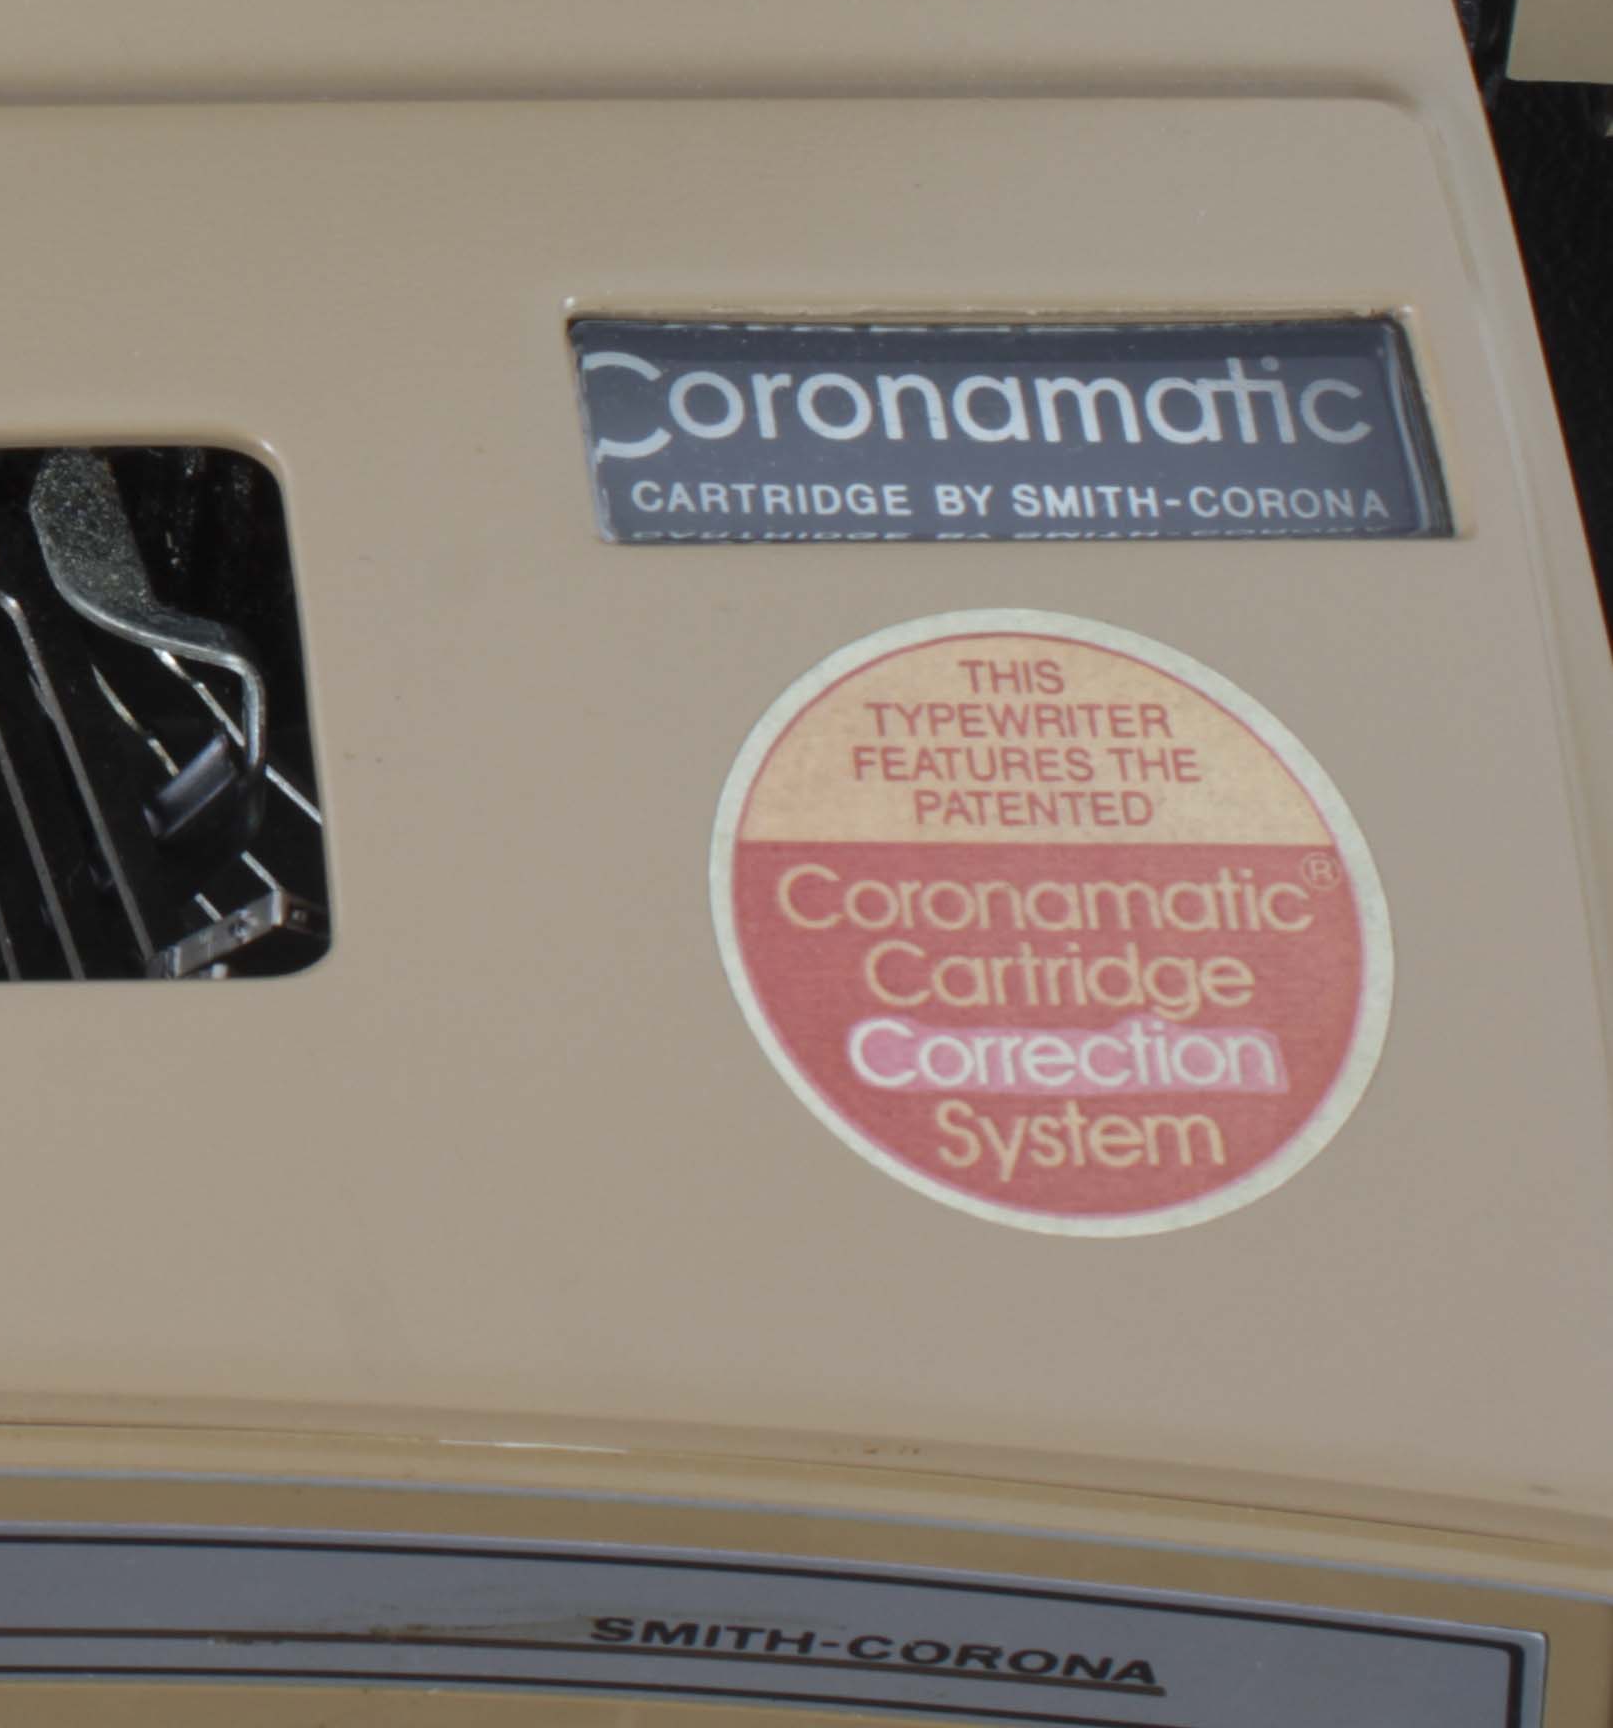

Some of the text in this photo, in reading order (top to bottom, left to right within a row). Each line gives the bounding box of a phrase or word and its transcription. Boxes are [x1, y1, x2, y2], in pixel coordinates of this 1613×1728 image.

[581, 352, 1373, 459] Coronamatic
[631, 480, 1389, 520] CARTRIDGE BY SMITH-CORONA
[957, 658, 1066, 695] THIS
[862, 701, 1173, 739] TYPEWRITER
[851, 745, 1202, 783] FEATURES THE
[913, 789, 1154, 827] PATENTED
[865, 940, 1255, 1020] Cartridge
[849, 1018, 1276, 1089] Correction
[933, 1100, 1225, 1182] System
[590, 1616, 1159, 1686] SMITH-CORONA
